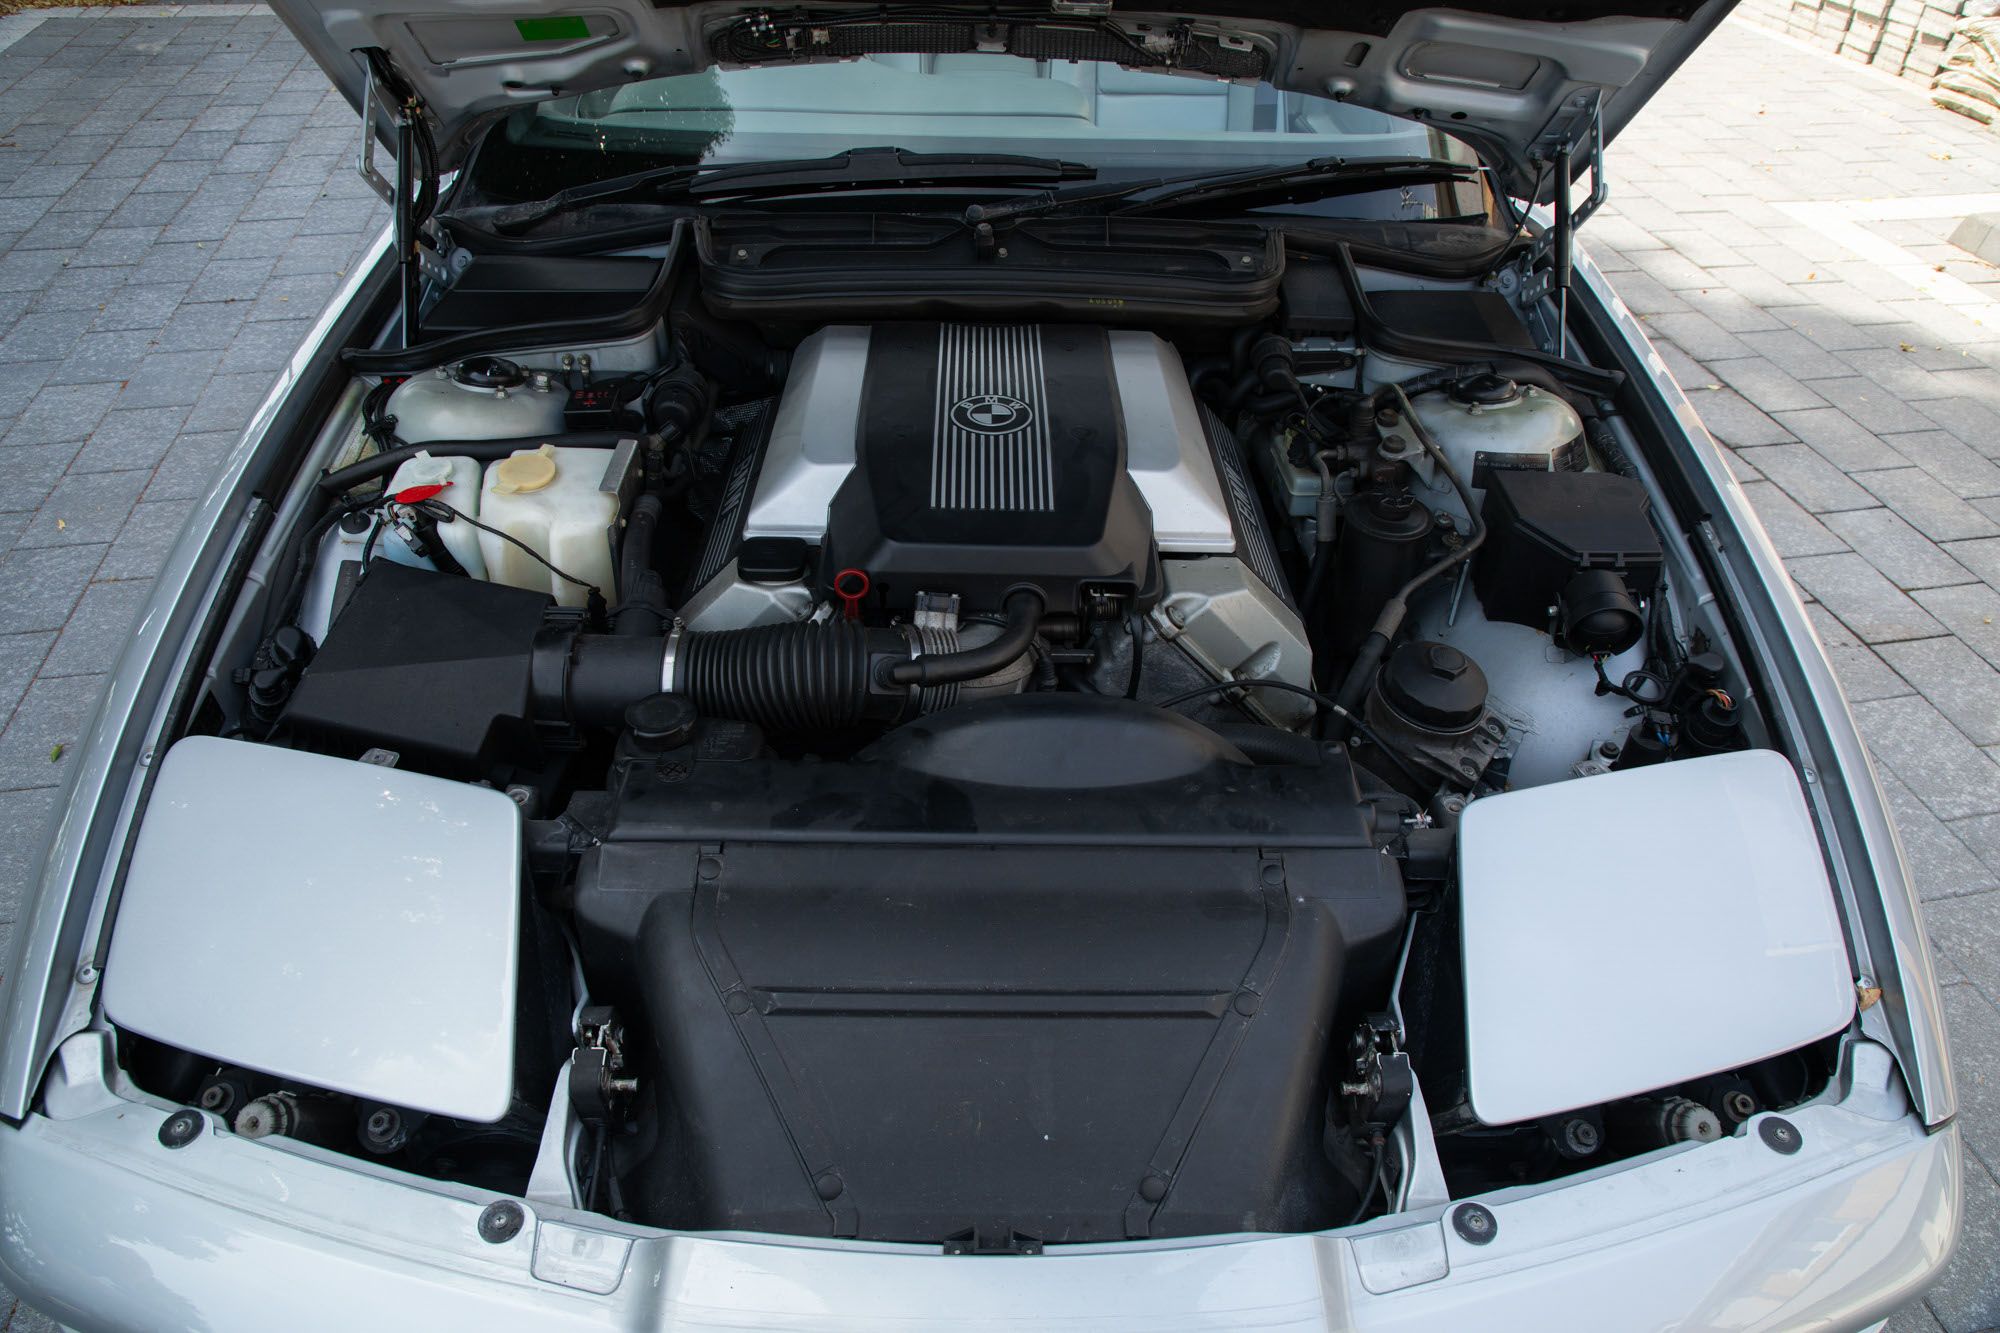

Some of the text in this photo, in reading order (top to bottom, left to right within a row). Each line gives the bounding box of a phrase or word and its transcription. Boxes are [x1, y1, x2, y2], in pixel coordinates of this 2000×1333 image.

[960, 395, 1024, 410] BMW
[722, 453, 753, 515] BMW
[1224, 460, 1257, 526] BMW
